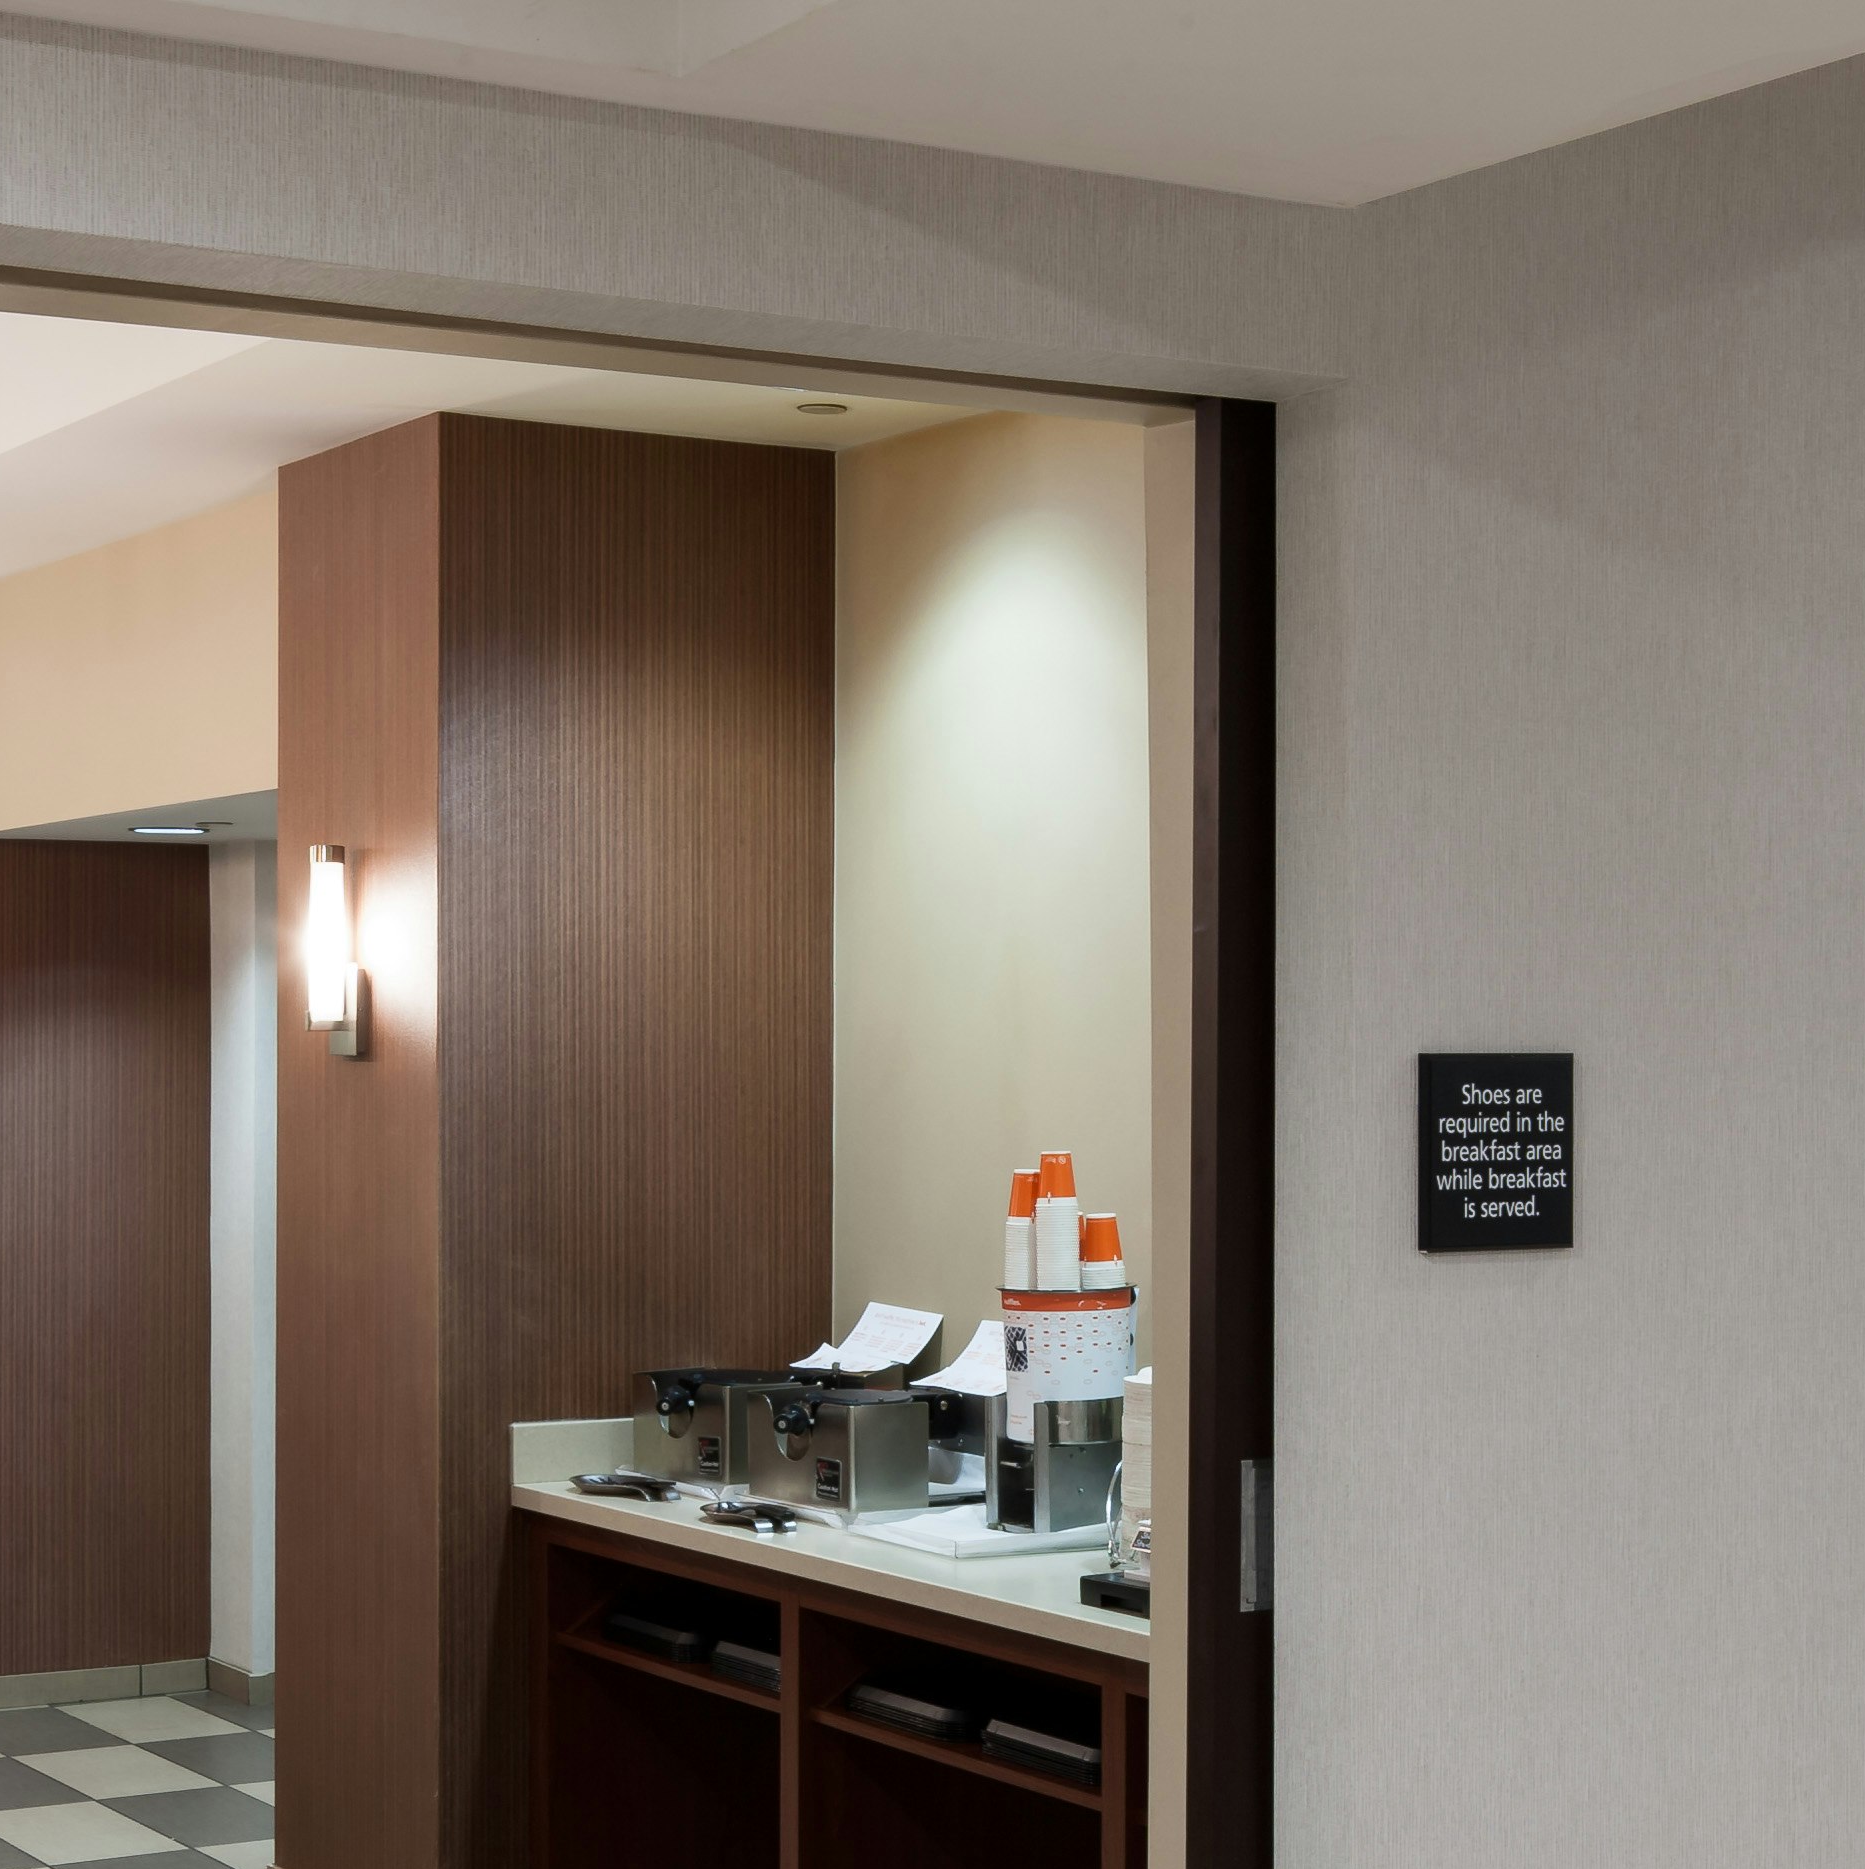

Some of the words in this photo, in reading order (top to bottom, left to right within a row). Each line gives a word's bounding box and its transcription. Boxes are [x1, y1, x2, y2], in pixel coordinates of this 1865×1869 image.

[1462, 1083, 1510, 1104] Shoes
[1516, 1089, 1542, 1104] are
[1439, 1111, 1510, 1138] required
[1517, 1112, 1531, 1132] in
[1537, 1111, 1564, 1132] the
[1442, 1139, 1521, 1161] breakfast
[1526, 1145, 1561, 1160] area
[1437, 1168, 1482, 1190] while
[1489, 1166, 1566, 1189] breakfast
[1465, 1197, 1475, 1218] is
[1481, 1195, 1539, 1217] served.
